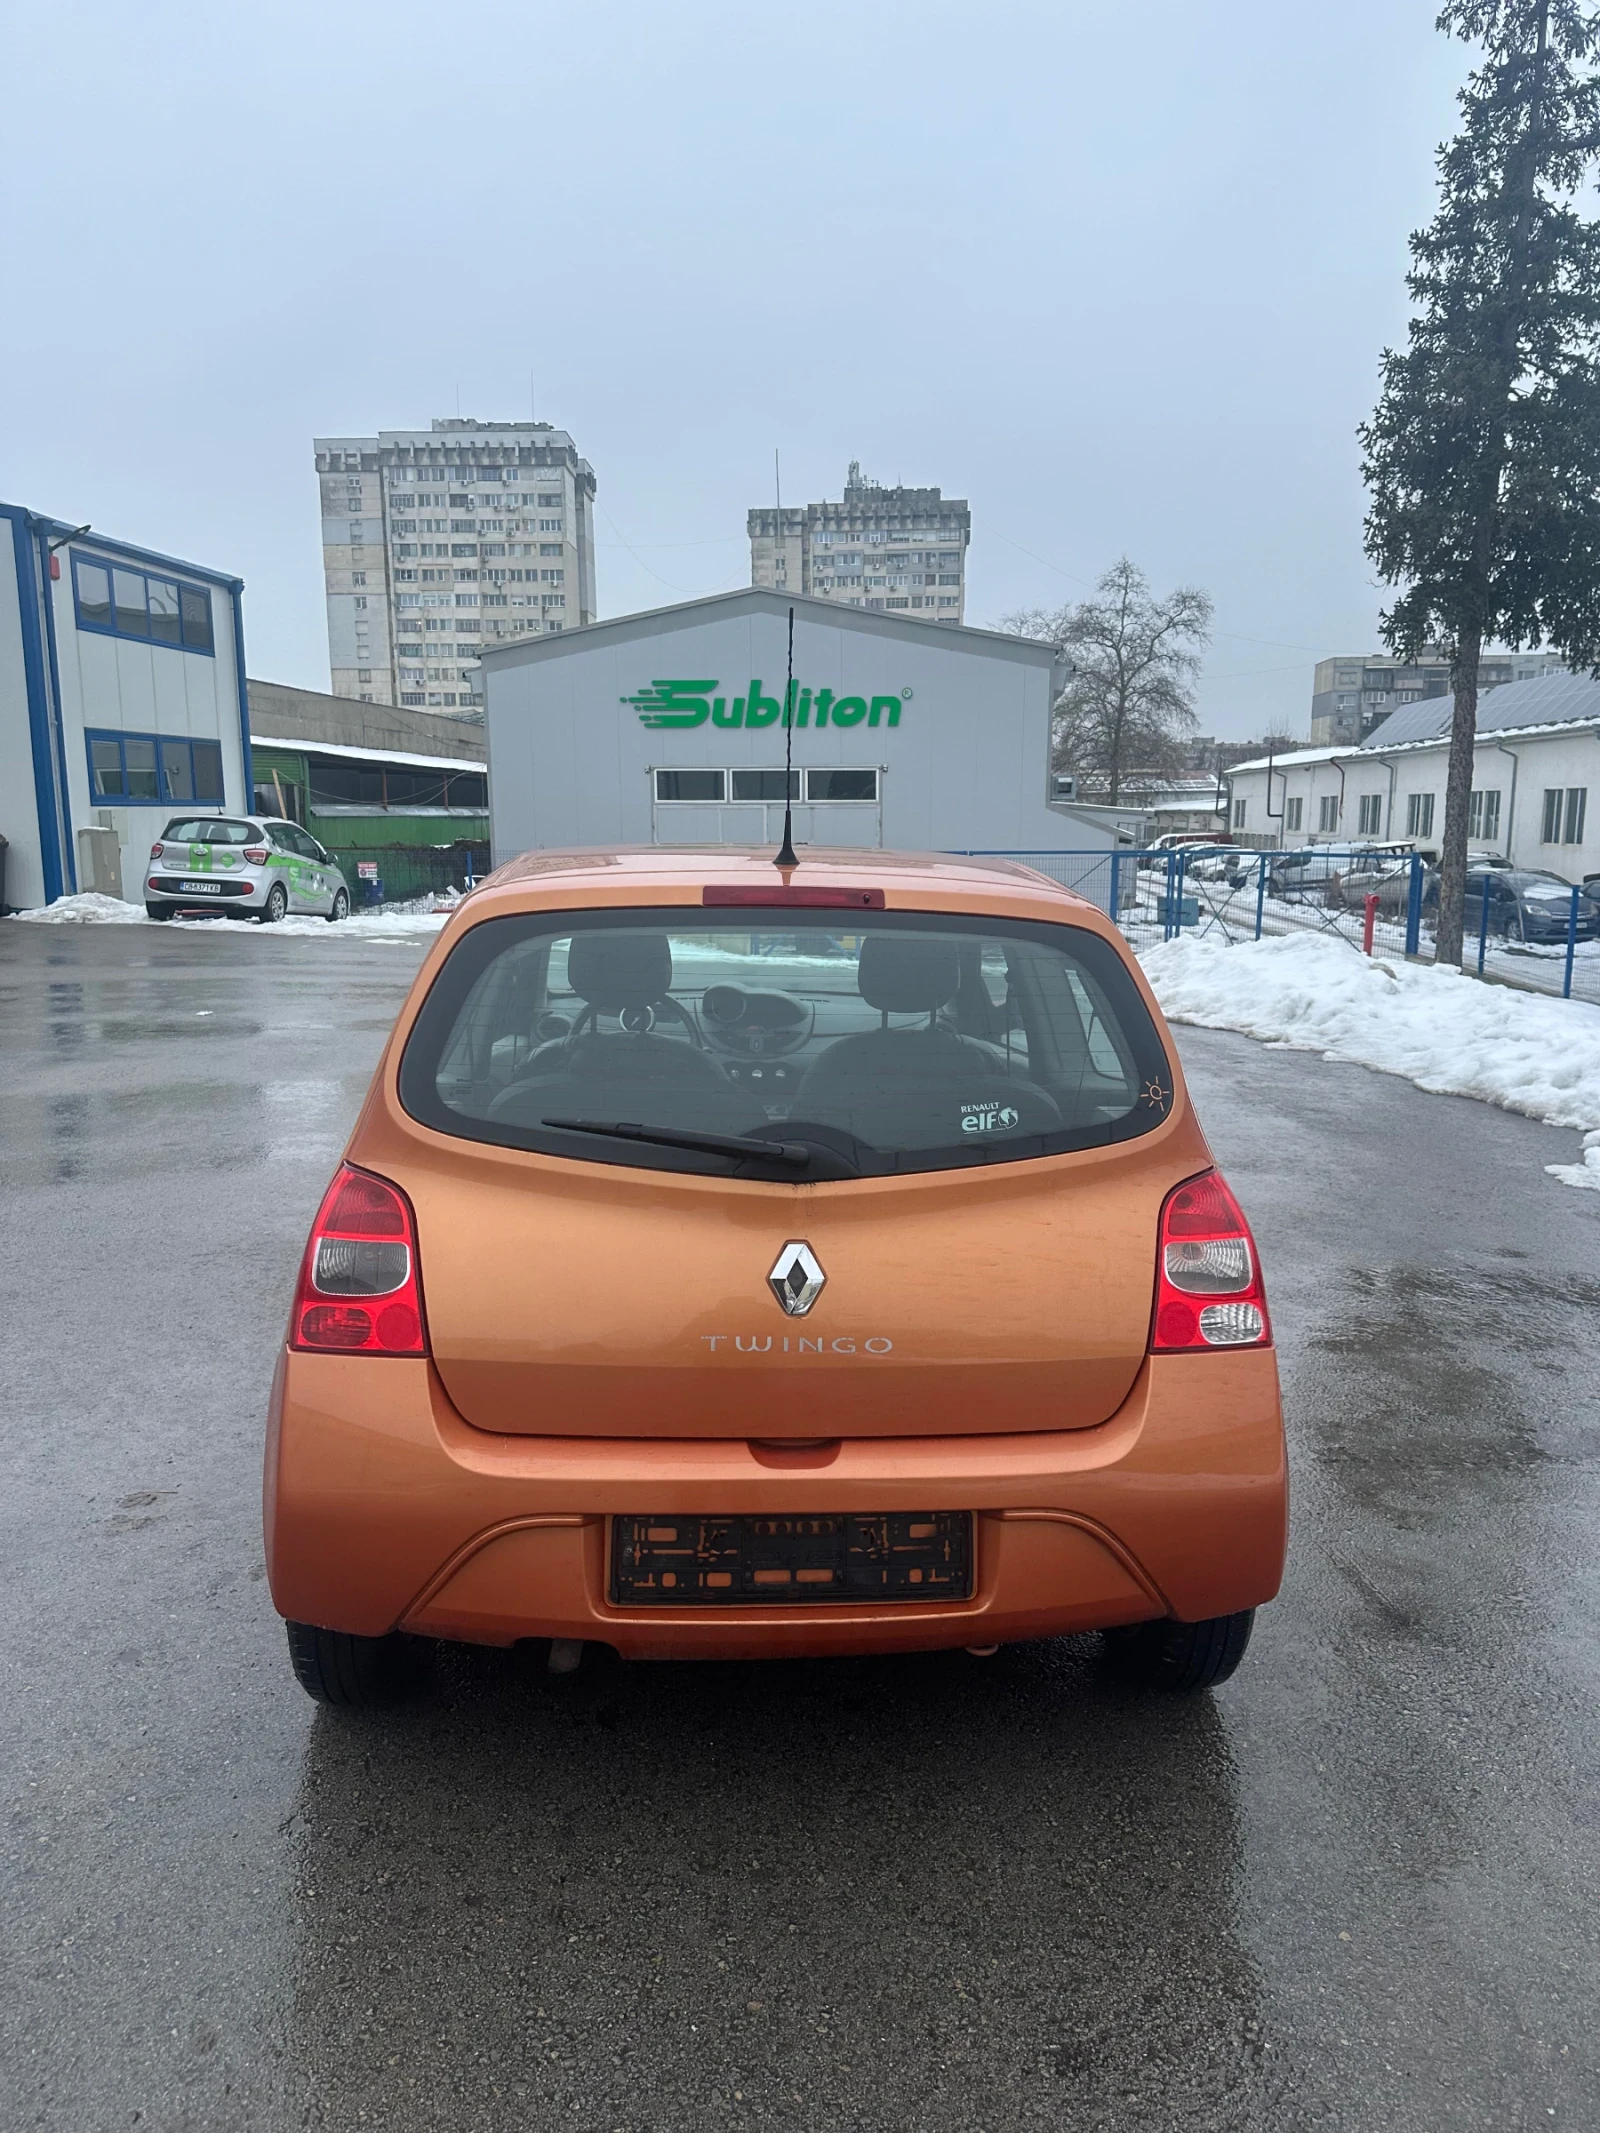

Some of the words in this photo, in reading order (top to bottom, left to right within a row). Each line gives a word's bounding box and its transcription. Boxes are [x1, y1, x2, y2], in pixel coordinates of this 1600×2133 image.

[960, 1102, 1000, 1113] RENAULT
[961, 1111, 997, 1131] elf
[700, 1335, 893, 1353] TWINGO
